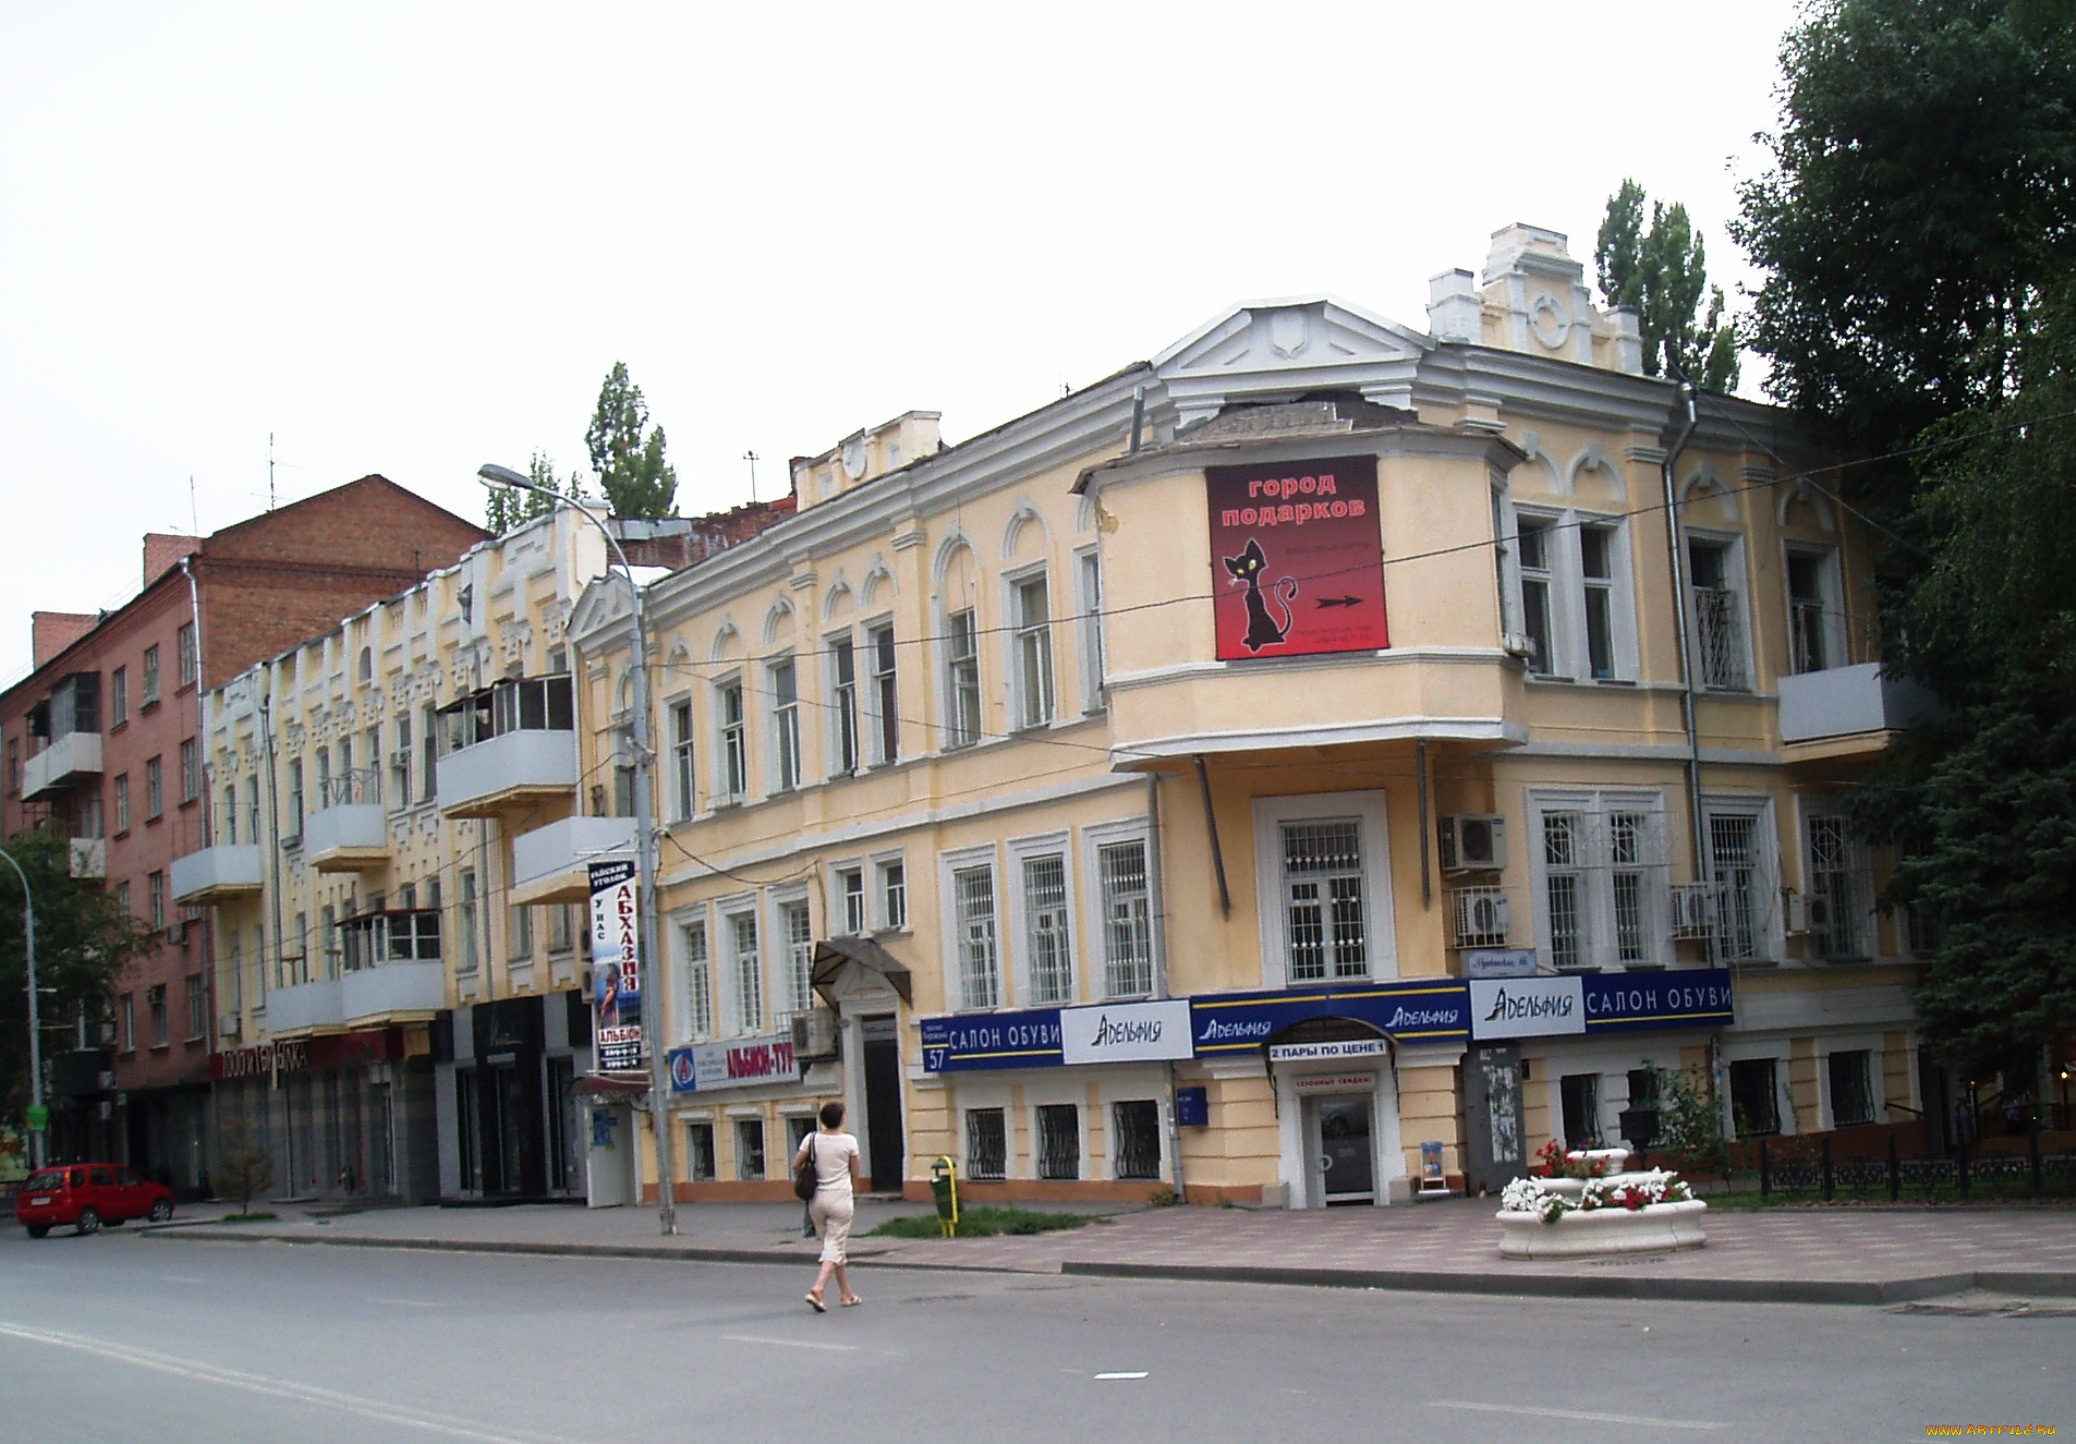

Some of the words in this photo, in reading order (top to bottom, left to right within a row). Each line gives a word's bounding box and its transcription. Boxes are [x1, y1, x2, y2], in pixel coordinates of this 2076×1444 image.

[1249, 474, 1337, 500] город
[1222, 499, 1366, 526] подарков
[617, 885, 639, 992] АБХАЗИЯ
[1586, 990, 1658, 1014] САЛОН
[1667, 986, 1732, 1008] ОБУВИ
[949, 1030, 1001, 1050] САЛОН
[1008, 1023, 1061, 1046] ОБУВИ
[929, 1049, 944, 1069] 57
[1272, 1049, 1279, 1058] 2
[1282, 1046, 1318, 1058] ПАРЫ
[1321, 1045, 1339, 1055] ПО
[1343, 1043, 1376, 1055] ЦЕНЕ
[1378, 1043, 1384, 1052] 1
